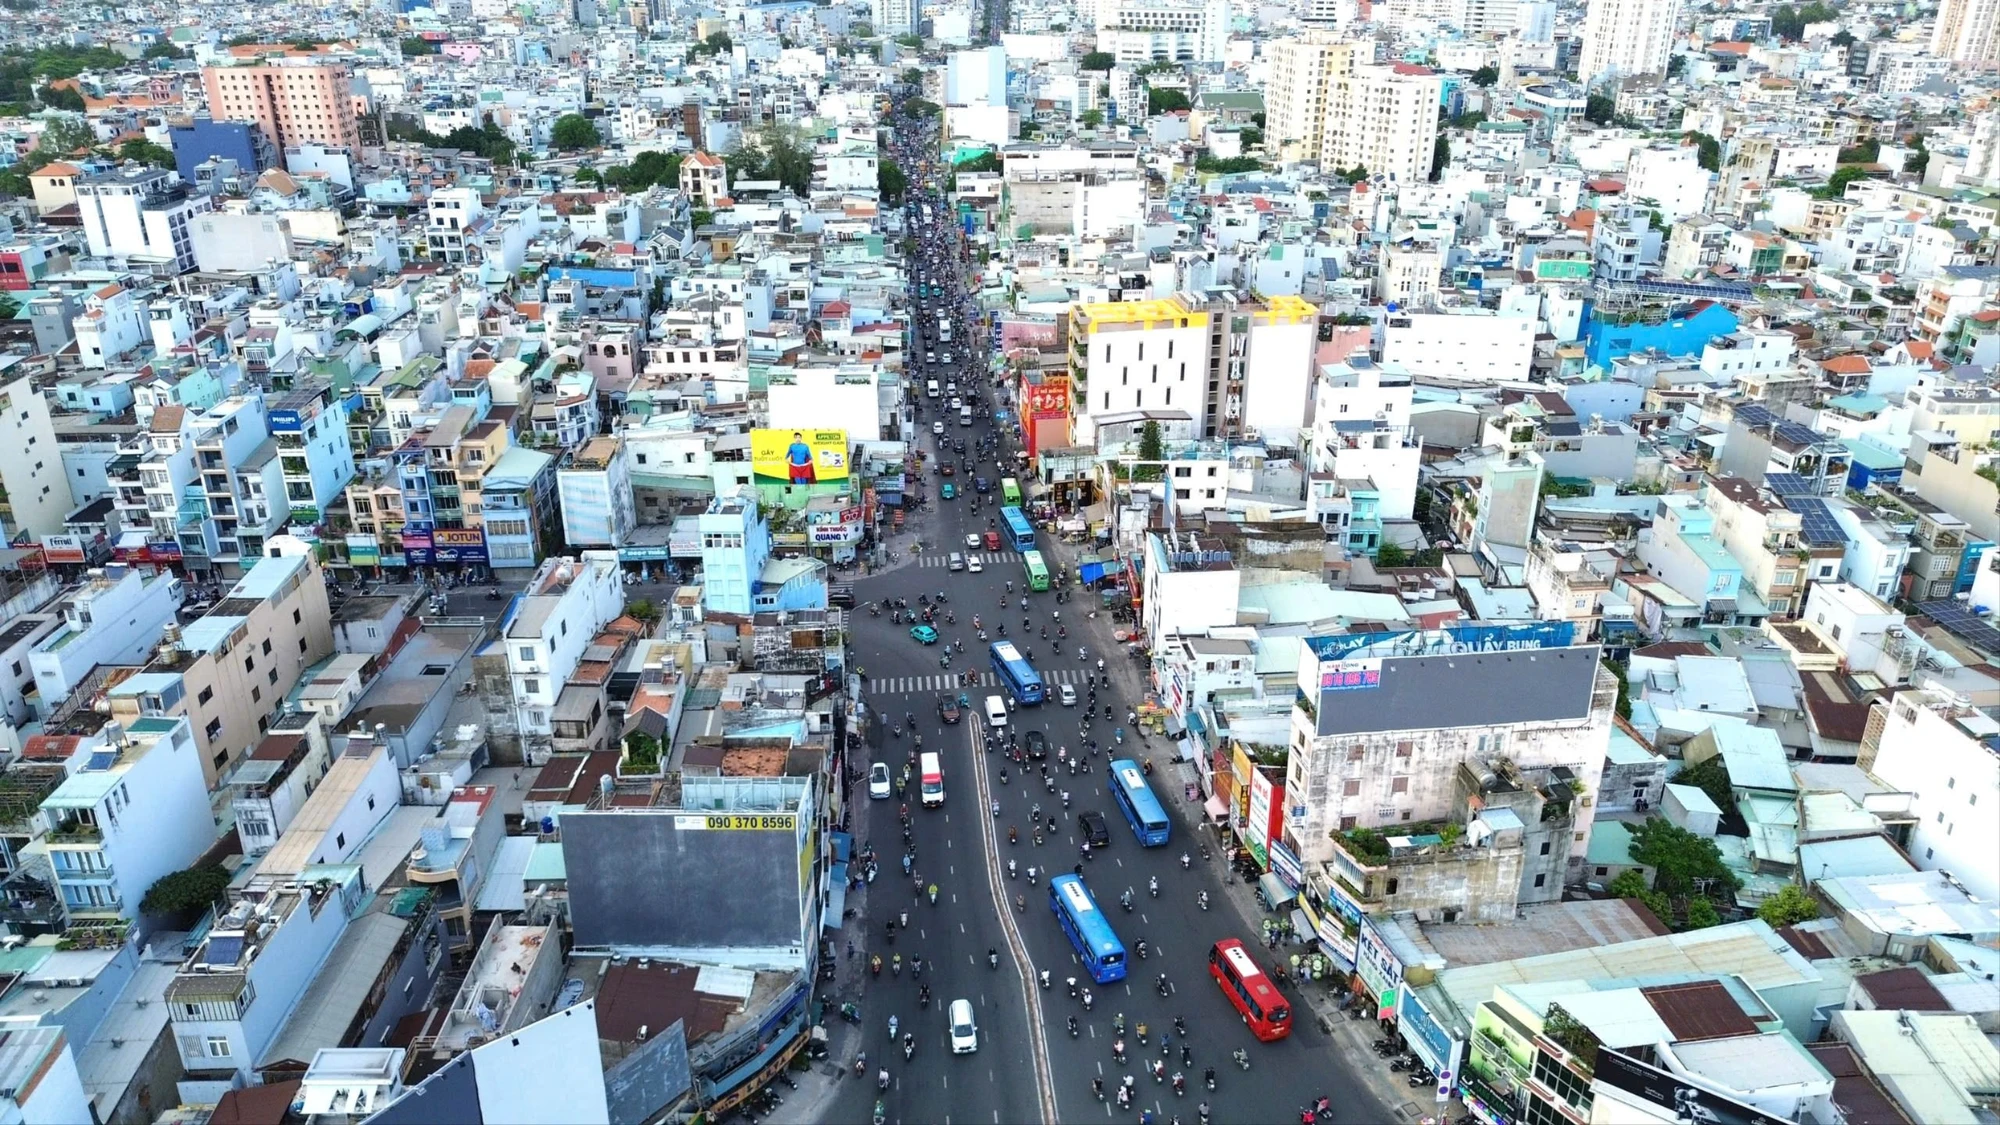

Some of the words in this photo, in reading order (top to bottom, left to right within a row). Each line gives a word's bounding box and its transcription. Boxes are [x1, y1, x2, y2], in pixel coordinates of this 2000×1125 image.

[447, 533, 480, 541] JOTUN
[1507, 640, 1540, 651] BUNG
[708, 817, 731, 828] 090
[735, 817, 758, 828] 370
[762, 817, 792, 828] 8596
